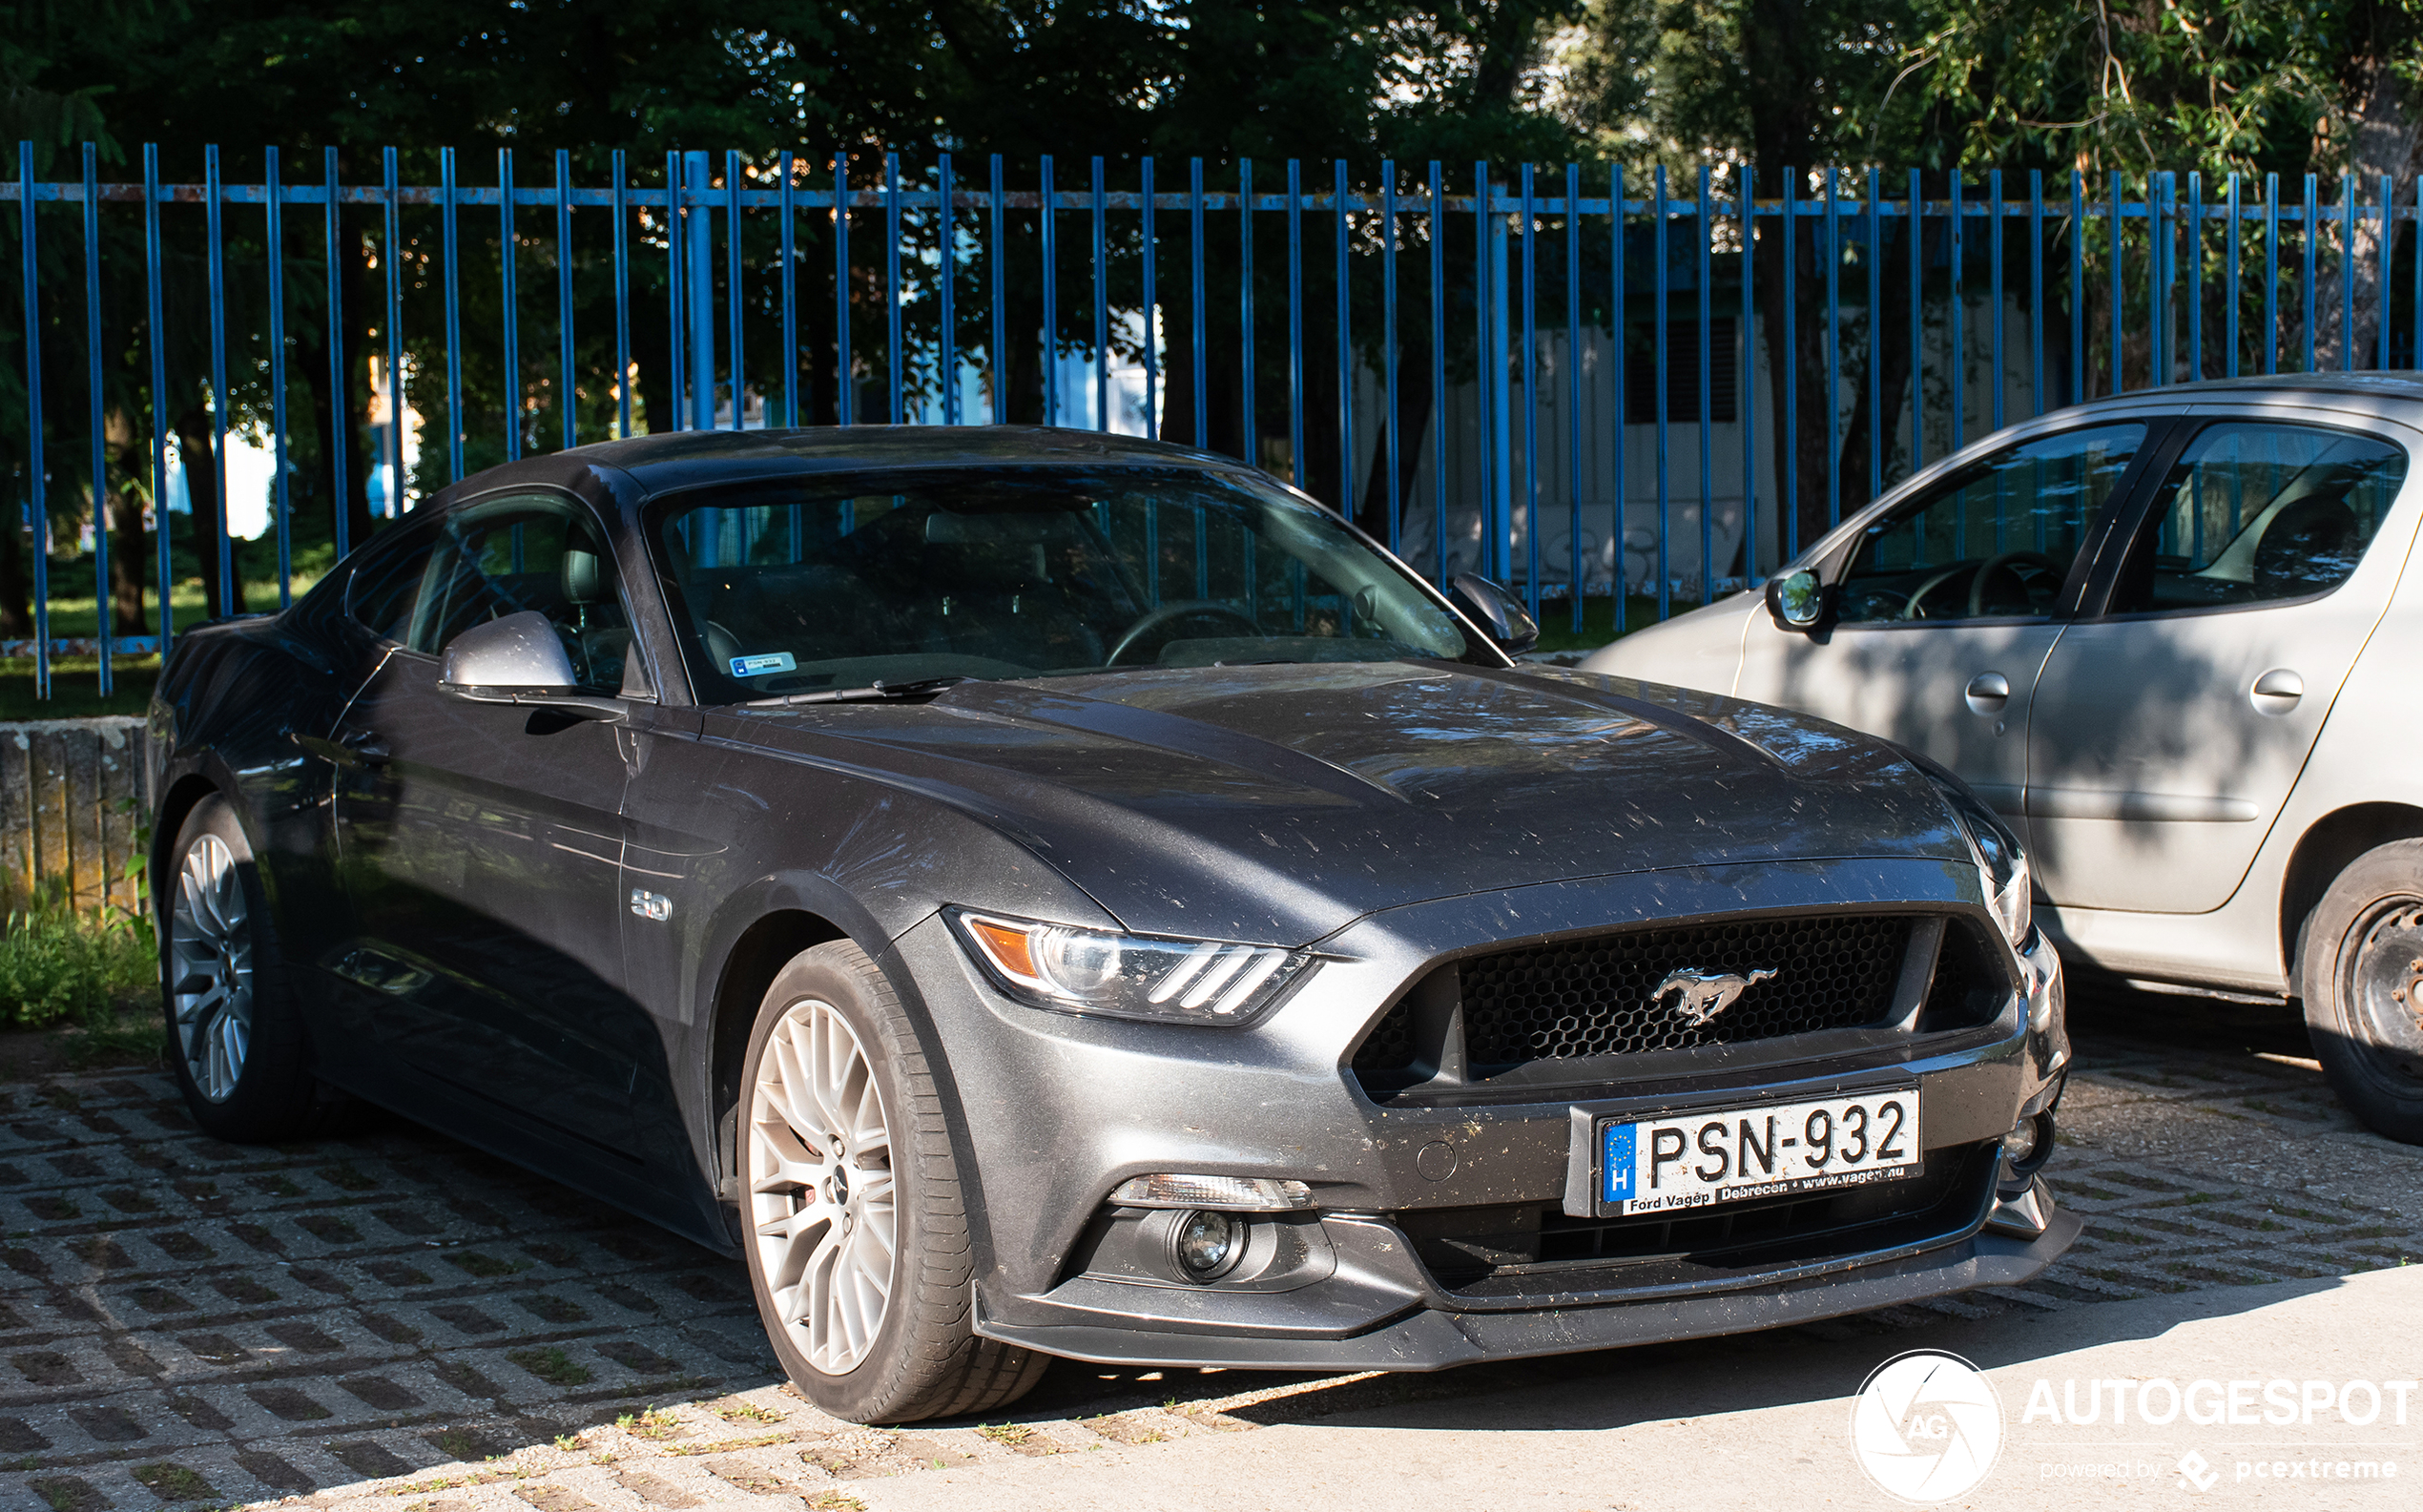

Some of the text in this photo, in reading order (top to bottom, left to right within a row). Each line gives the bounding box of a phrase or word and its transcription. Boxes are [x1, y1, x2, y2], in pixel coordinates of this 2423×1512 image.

[1650, 1100, 1905, 1190] PSN-932
[1612, 1168, 1627, 1191] H
[1629, 1196, 1661, 1212] Ford
[1666, 1191, 1710, 1208] Vagép
[1721, 1182, 1788, 1200] Debrecen
